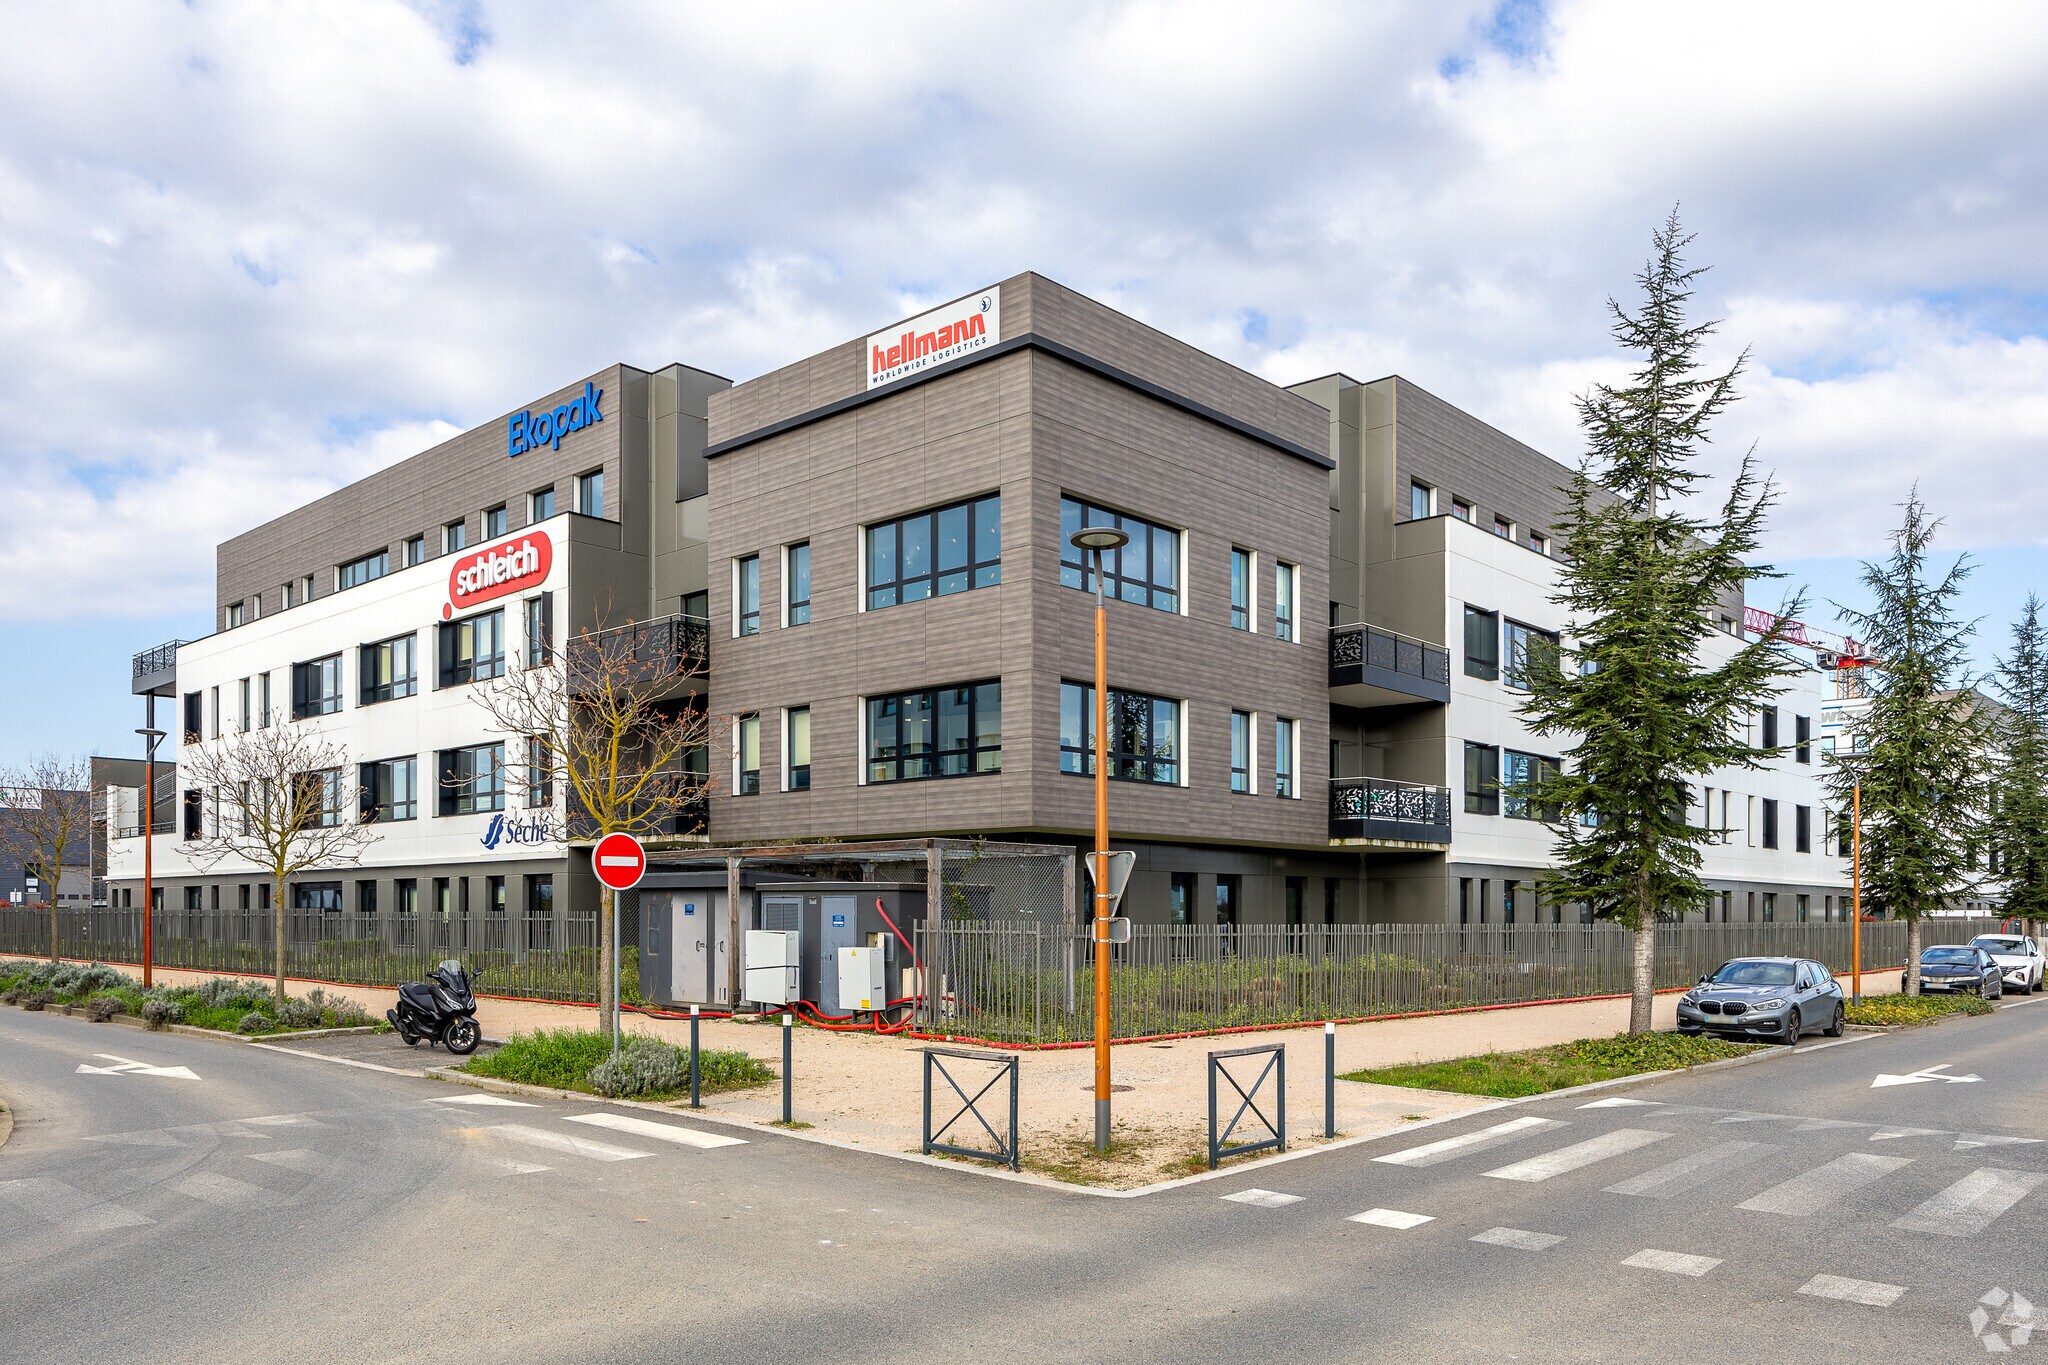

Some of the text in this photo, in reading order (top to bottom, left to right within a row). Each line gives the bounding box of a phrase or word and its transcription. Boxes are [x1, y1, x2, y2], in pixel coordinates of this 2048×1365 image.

[872, 313, 986, 375] hellmann
[872, 336, 987, 384] WORLDWIDE LOGISTICS
[508, 382, 603, 457] Ekopak
[456, 539, 539, 597] schleich
[505, 815, 550, 844] Séché
